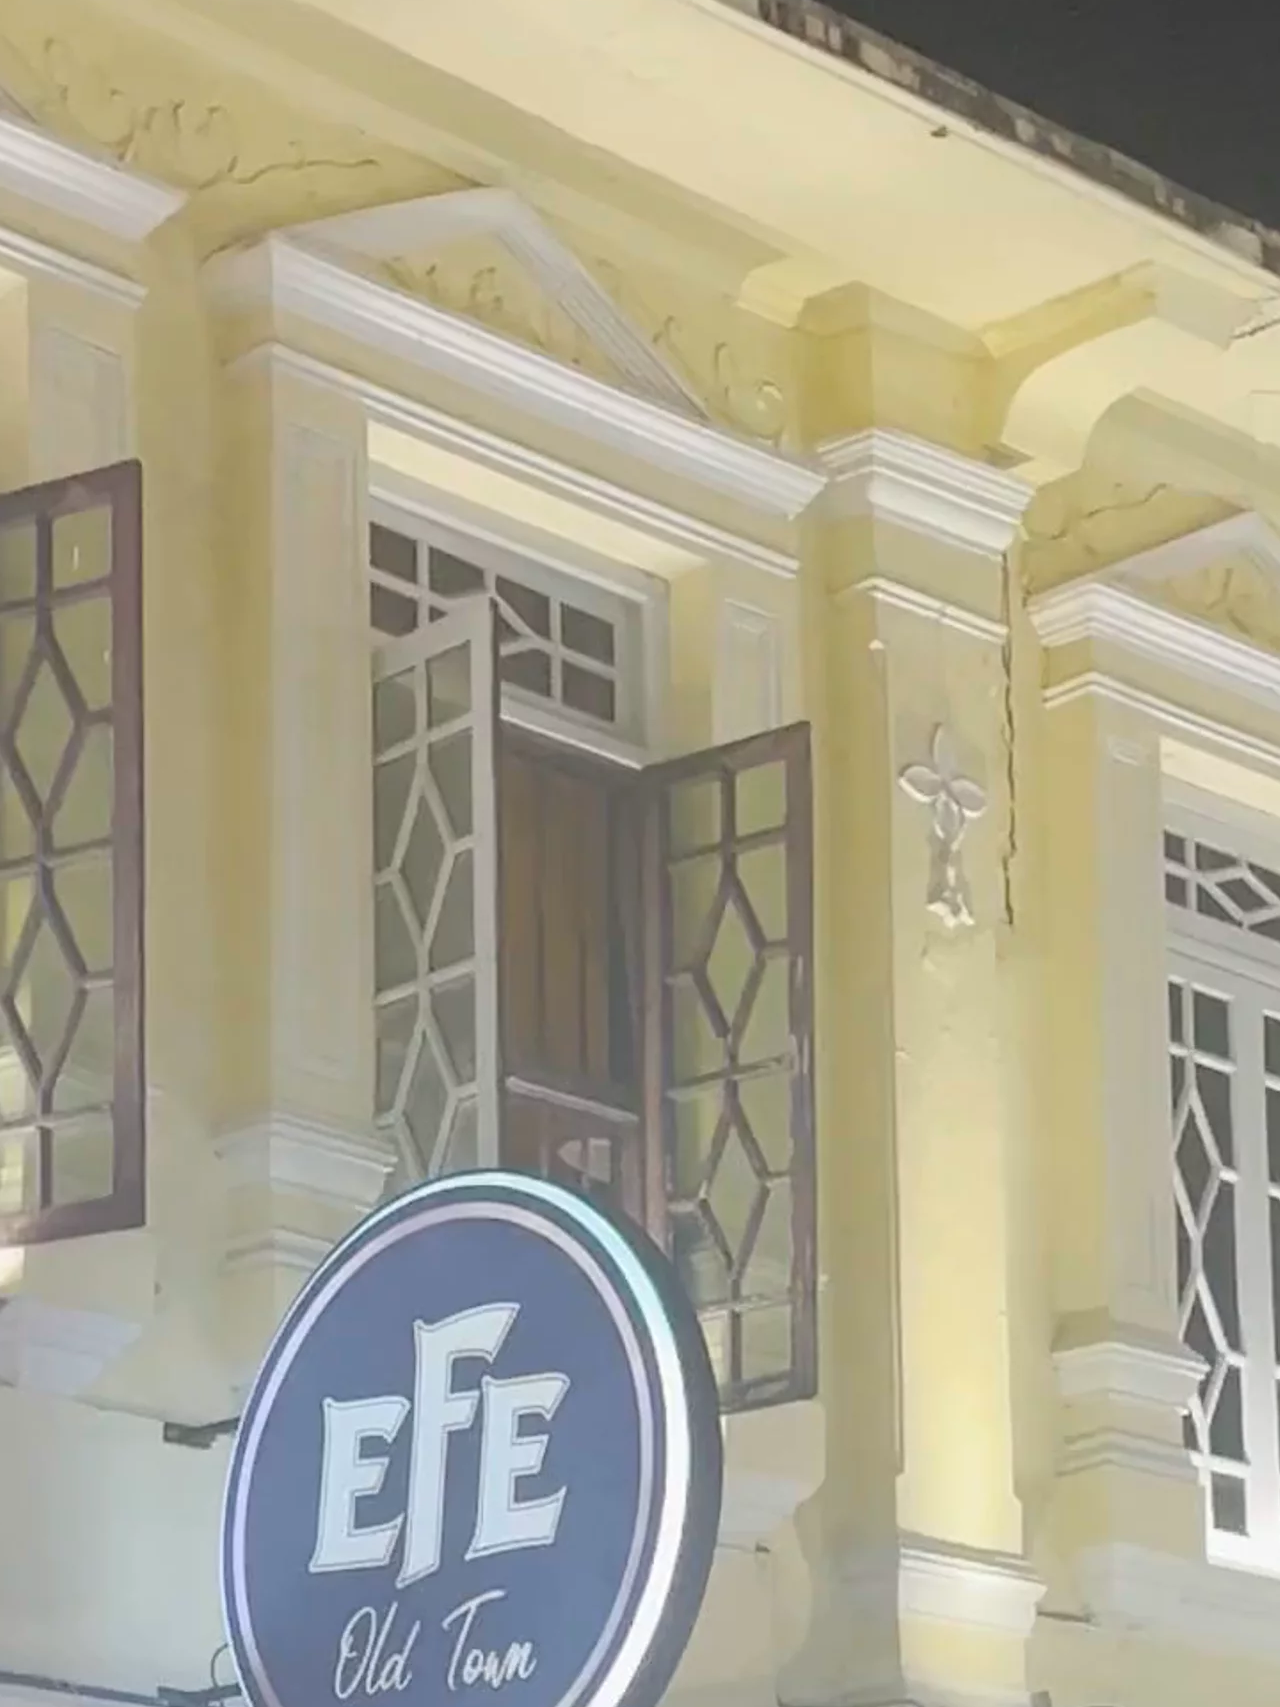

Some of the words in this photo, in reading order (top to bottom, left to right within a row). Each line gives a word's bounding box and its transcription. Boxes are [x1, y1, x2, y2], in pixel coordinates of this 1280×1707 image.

[307, 1300, 572, 1590] EFE
[333, 1599, 421, 1700] Old
[441, 1588, 538, 1693] Town
